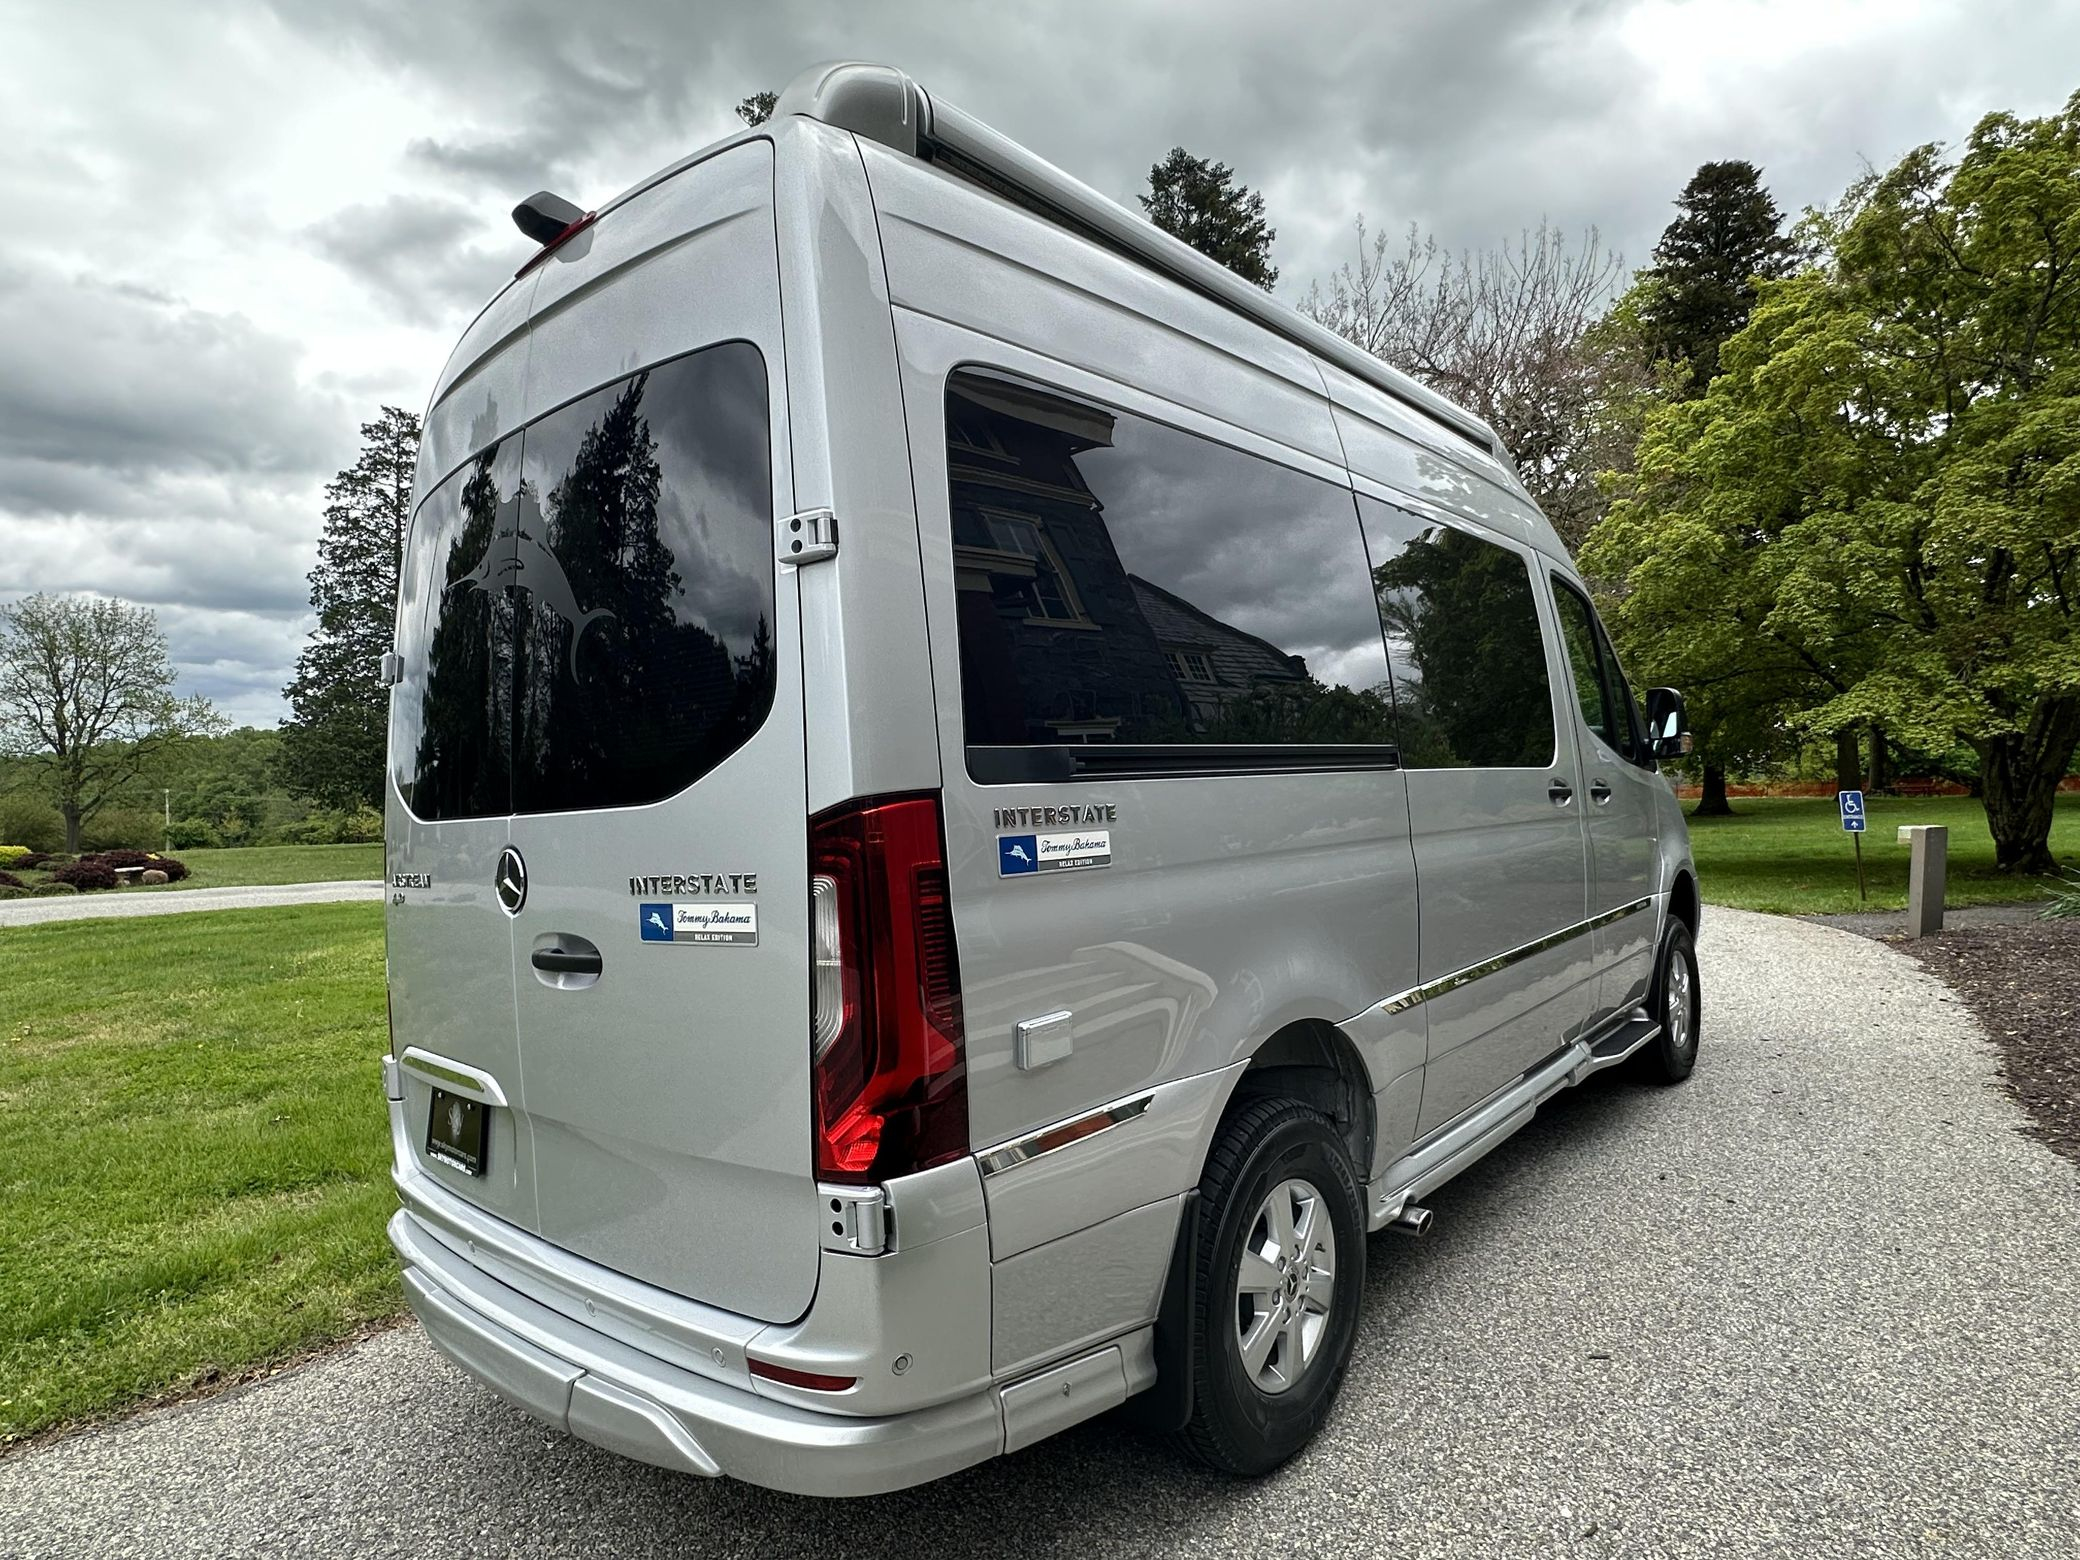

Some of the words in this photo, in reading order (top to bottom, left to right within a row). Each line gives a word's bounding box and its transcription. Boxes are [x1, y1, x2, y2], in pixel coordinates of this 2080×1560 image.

[993, 803, 1118, 829] INTERSTATE
[1041, 839, 1073, 856] Tommy
[1071, 837, 1107, 851] Bahama
[1058, 859, 1074, 868] RELAX
[1074, 858, 1093, 866] EDITION
[629, 872, 758, 896] INTERSTATE
[677, 909, 710, 929] Tommy
[709, 909, 751, 924] Bahama
[694, 933, 711, 941] RELAX
[711, 933, 733, 942] EDITION
